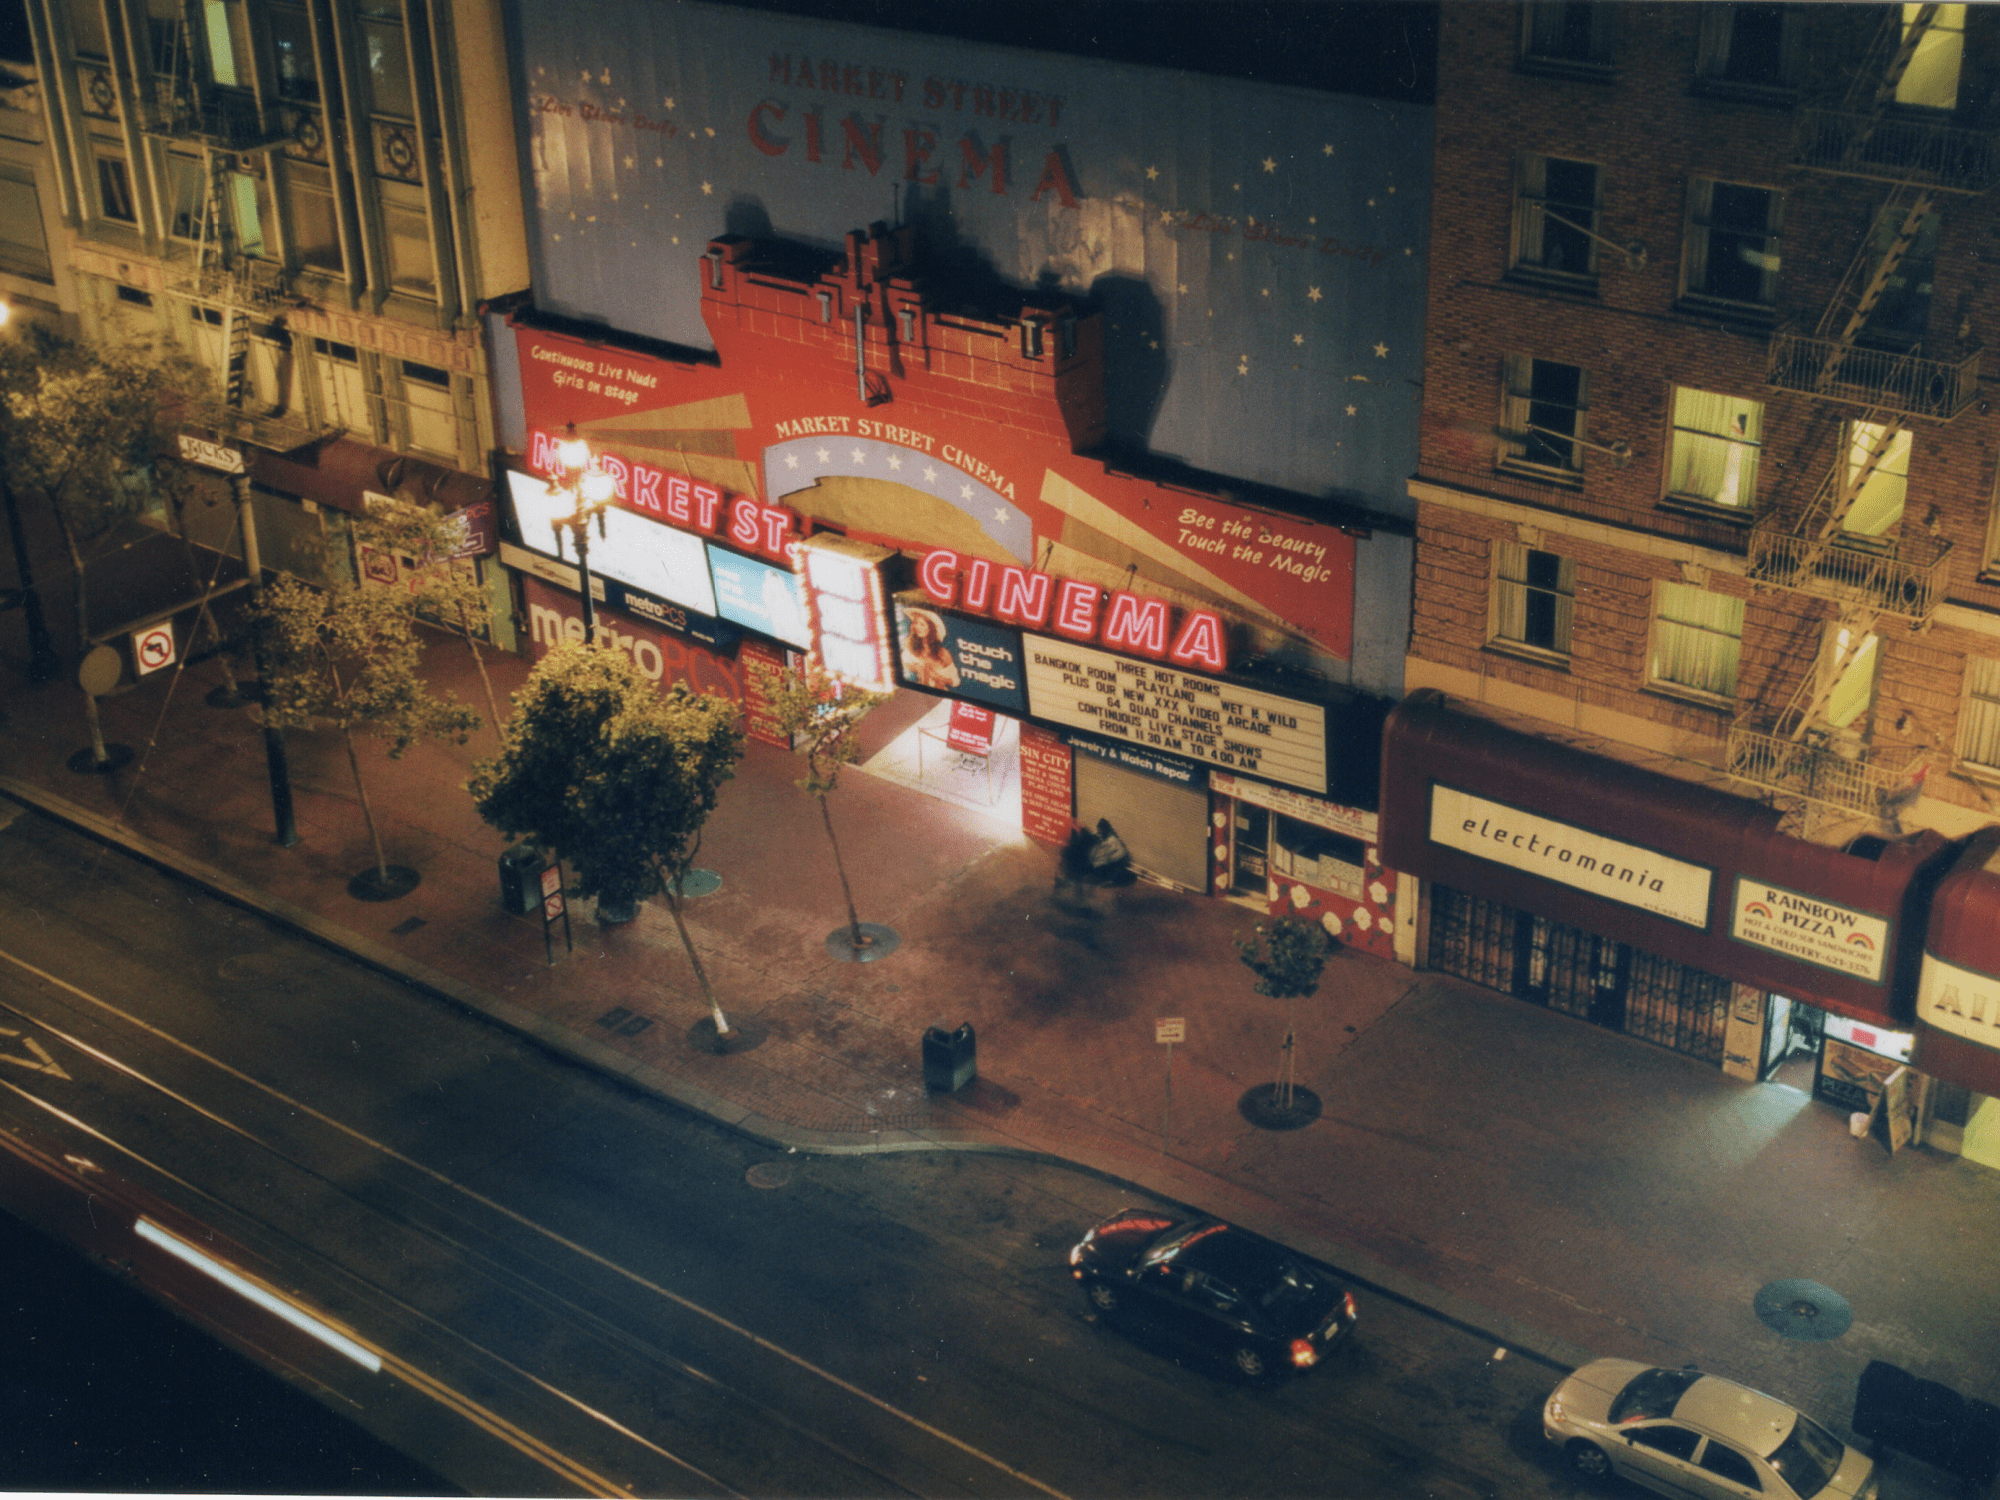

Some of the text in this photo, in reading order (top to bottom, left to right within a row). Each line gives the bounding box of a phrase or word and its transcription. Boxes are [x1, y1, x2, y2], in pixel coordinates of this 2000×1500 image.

[768, 55, 1065, 128] MARKET STREET
[747, 103, 1081, 210] CINEMA
[531, 345, 658, 389] Continuous Live Nude
[553, 370, 639, 406] Girls on stage
[775, 416, 1016, 500] MARKET STREET CINEMA
[531, 431, 719, 530] MRKET
[1178, 508, 1216, 530] See
[1221, 520, 1253, 540] the
[1178, 528, 1332, 583] Touch the Magic
[624, 592, 687, 627] metroPCS
[921, 550, 1222, 666] CINEMA
[957, 638, 1014, 662] touch
[959, 652, 993, 670] the
[961, 667, 1018, 690] magic
[1034, 653, 1298, 729] BANGKOK ROOM PLAYLAND WET N WILD
[1115, 661, 1221, 697] THREE HOT ROOMS
[1063, 673, 1272, 737] PLUS OUR NEW XXX VIDEO ARCADE
[1107, 696, 1223, 737] 64 QUAD CHANNELS
[1078, 701, 1263, 760] CONTINUOUS LIVE STAGE SHOWS
[1100, 720, 1129, 736] FROM
[1191, 743, 1205, 756] TO
[1239, 757, 1259, 770] AM
[1020, 745, 1071, 769] SIN CITY
[1067, 735, 1107, 757] Jewelry
[1108, 747, 1118, 759] &
[1120, 751, 1154, 770] Watch
[1155, 762, 1191, 782] Repair
[1461, 818, 1666, 893] electromania
[1744, 917, 1763, 928] HOT
[1764, 923, 1771, 931] &
[1773, 925, 1798, 939] COLD
[1766, 889, 1858, 928] RAINBOW
[1782, 911, 1836, 939] PIZZA
[1743, 928, 1767, 943] FREE
